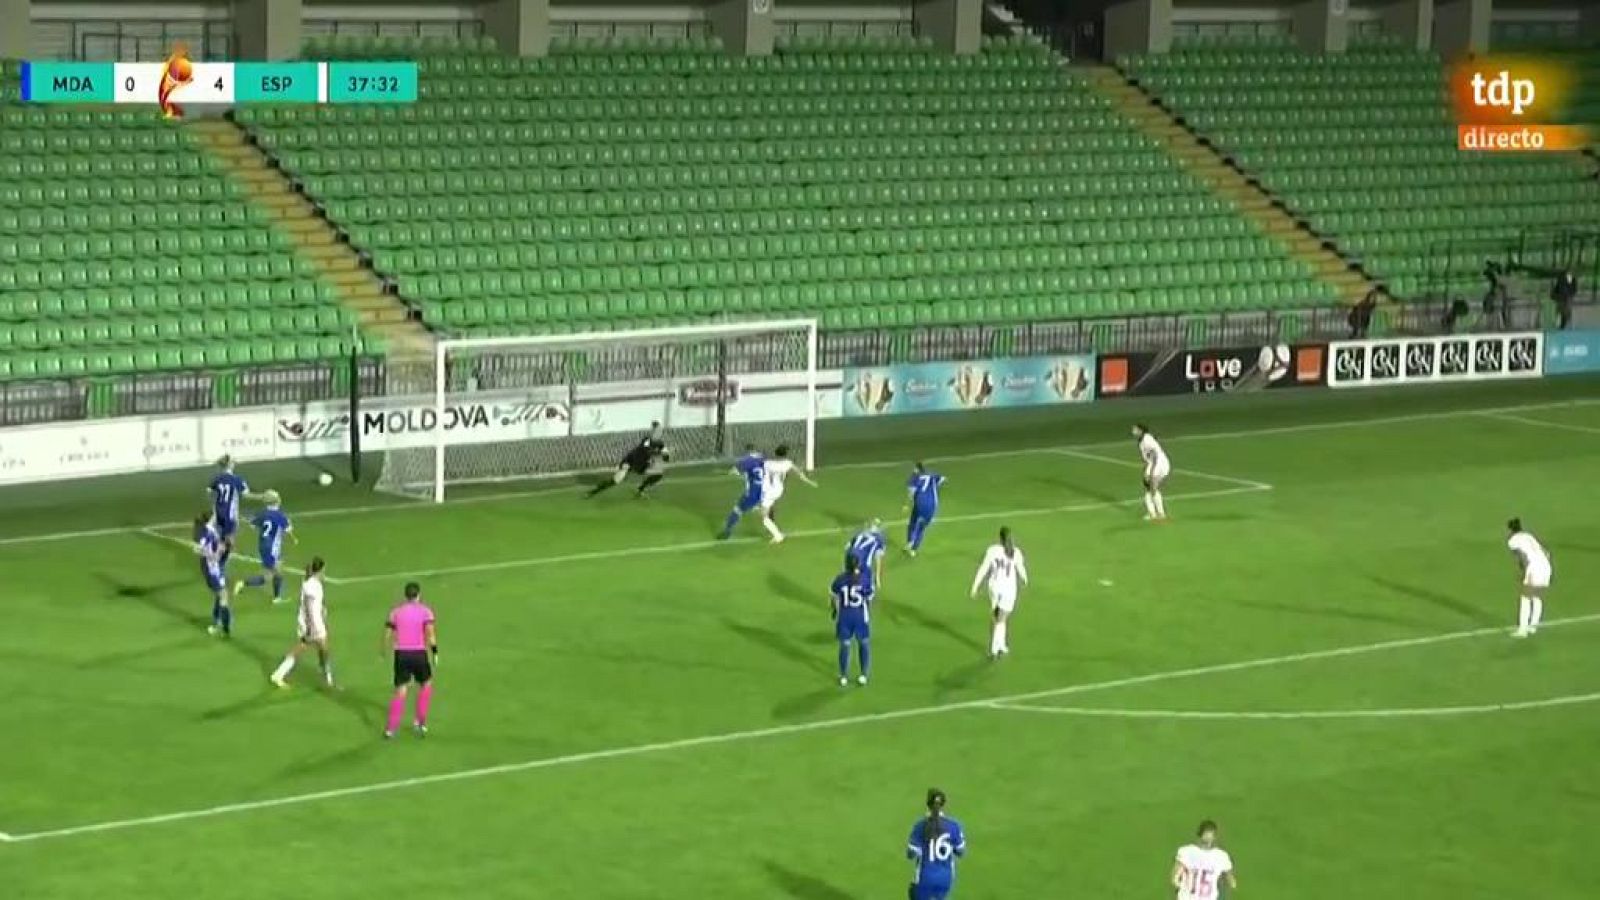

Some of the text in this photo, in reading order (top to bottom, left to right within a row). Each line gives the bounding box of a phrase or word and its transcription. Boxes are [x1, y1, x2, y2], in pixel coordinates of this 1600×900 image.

[1185, 354, 1242, 379] Love
[363, 405, 489, 435] MOLDOVA
[919, 475, 931, 492] 7
[263, 521, 273, 537] 2
[841, 585, 863, 607] 15
[929, 832, 952, 862] 16
